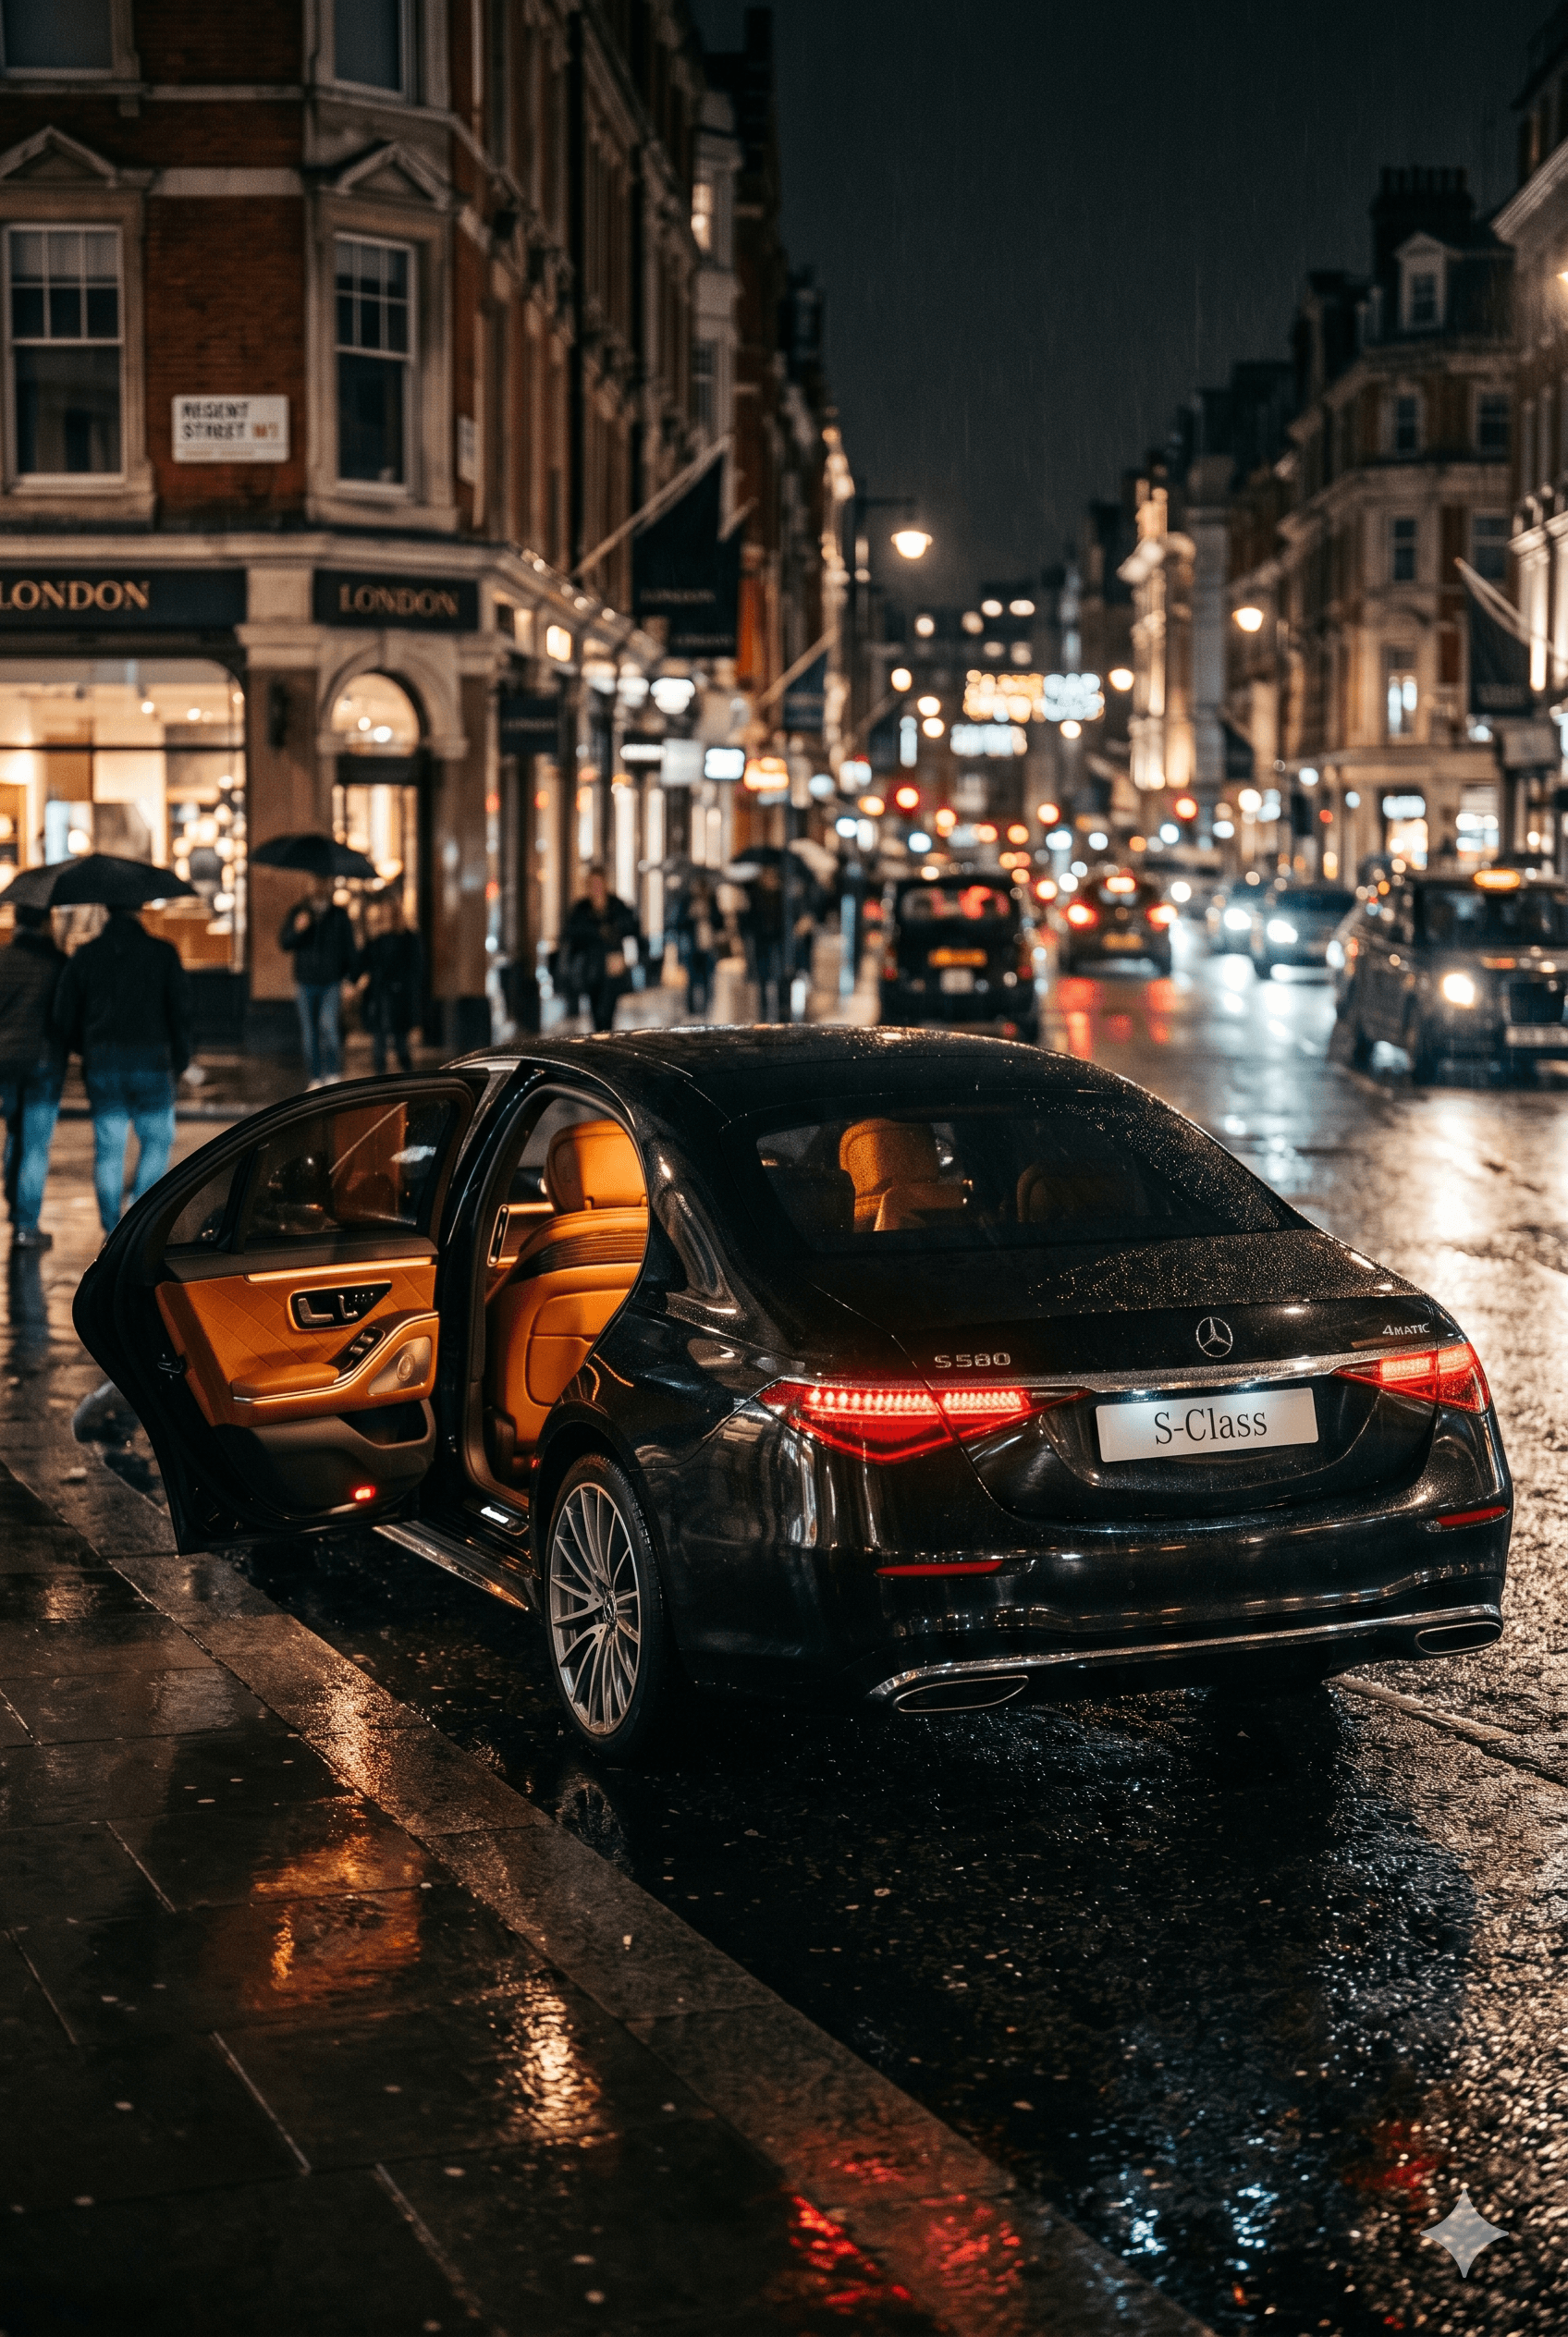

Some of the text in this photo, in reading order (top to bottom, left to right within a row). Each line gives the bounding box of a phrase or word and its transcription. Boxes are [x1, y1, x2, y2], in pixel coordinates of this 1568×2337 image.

[184, 422, 245, 439] STREET
[339, 583, 459, 618] LONDON
[1382, 1322, 1430, 1336] 4MATIC
[1154, 1407, 1268, 1445] S-Class
